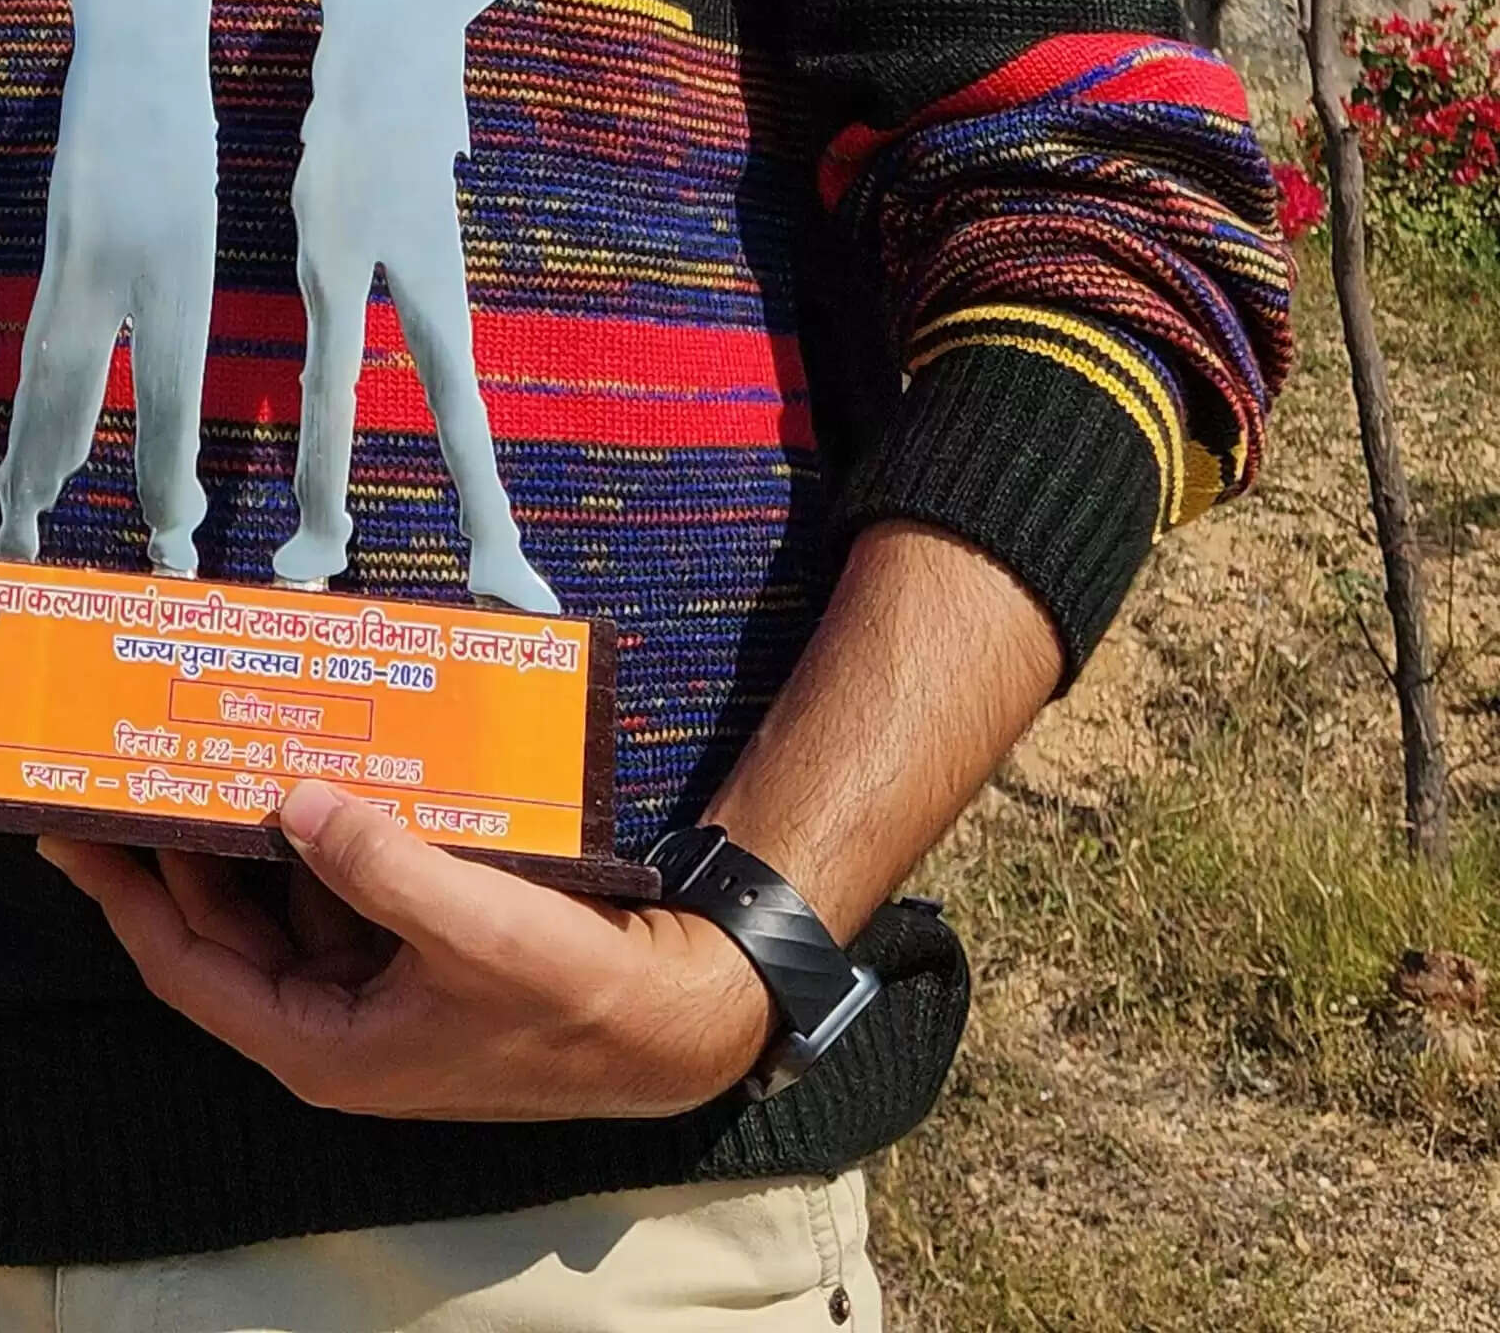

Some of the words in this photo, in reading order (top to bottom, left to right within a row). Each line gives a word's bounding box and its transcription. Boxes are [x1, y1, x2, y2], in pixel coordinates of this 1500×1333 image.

[28, 586, 115, 620] कल्याण
[120, 588, 156, 624] एवं
[160, 594, 244, 633] प्रान्तीय
[248, 612, 309, 639] रक्षक
[313, 616, 358, 643] दल
[362, 610, 445, 656] विभाग,
[452, 631, 515, 664] उत्तर
[520, 629, 578, 669] प्रदेश
[116, 637, 174, 661] राज्य
[180, 642, 230, 675] युवा
[231, 648, 299, 674] उत्सव
[280, 704, 321, 729] स्थान
[116, 721, 179, 755] दिनांक
[285, 740, 358, 776] दिसम्बर
[366, 757, 422, 783] 2025
[22, 763, 86, 791] स्थान
[128, 768, 209, 804] इन्दिरा
[219, 774, 285, 811] गाँधी
[416, 804, 509, 835] लखनऊ
